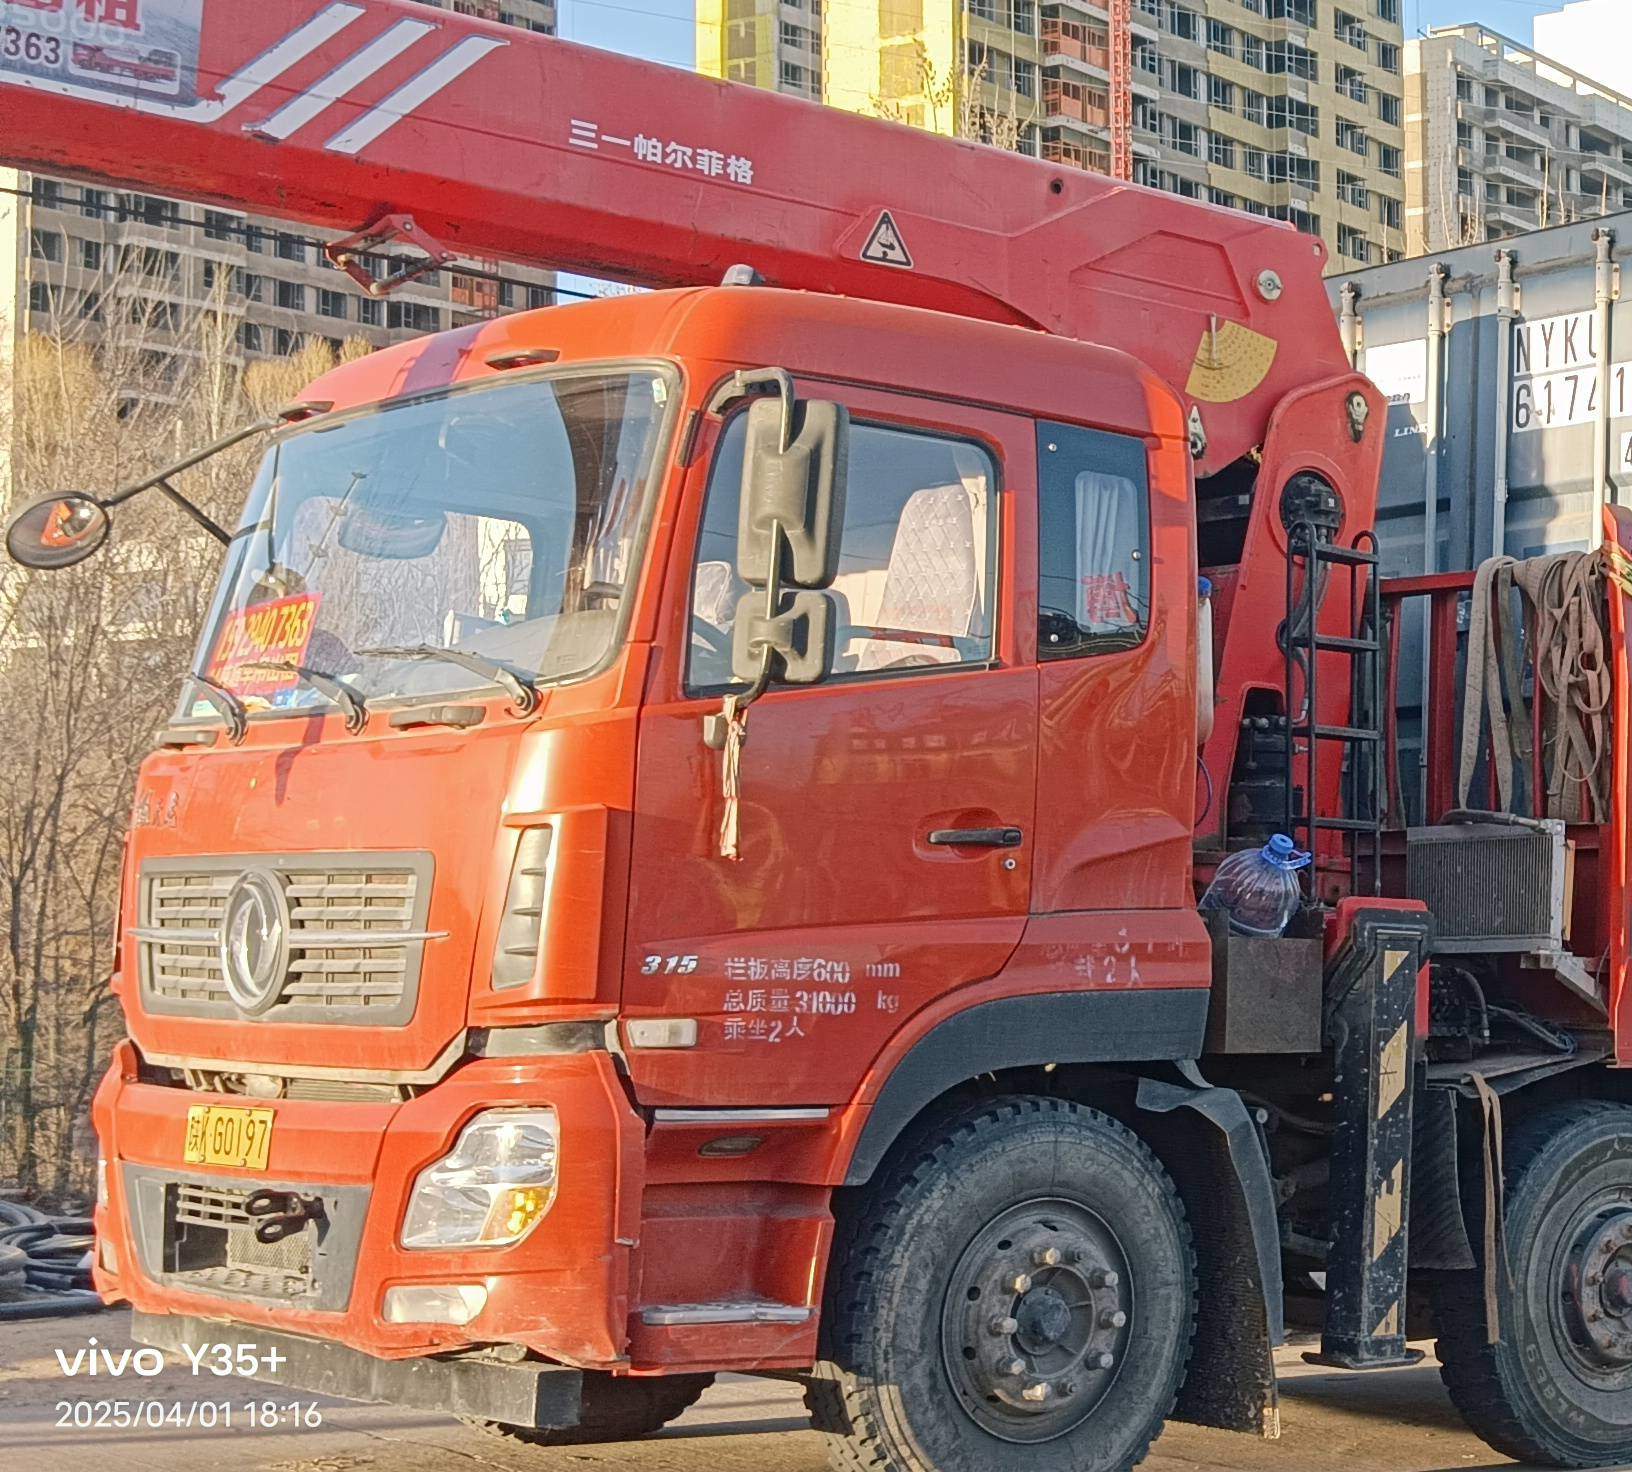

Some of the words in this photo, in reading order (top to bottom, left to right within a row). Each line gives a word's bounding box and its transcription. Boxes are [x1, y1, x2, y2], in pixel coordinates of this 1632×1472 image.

[0, 25, 61, 65] 363
[569, 119, 755, 185] 三一帕尔菲格
[639, 954, 699, 976] 315
[866, 961, 900, 978] mm
[722, 989, 857, 1016] 总质量31000
[877, 989, 899, 1013] kg
[723, 1015, 806, 1043] 乘坐2人
